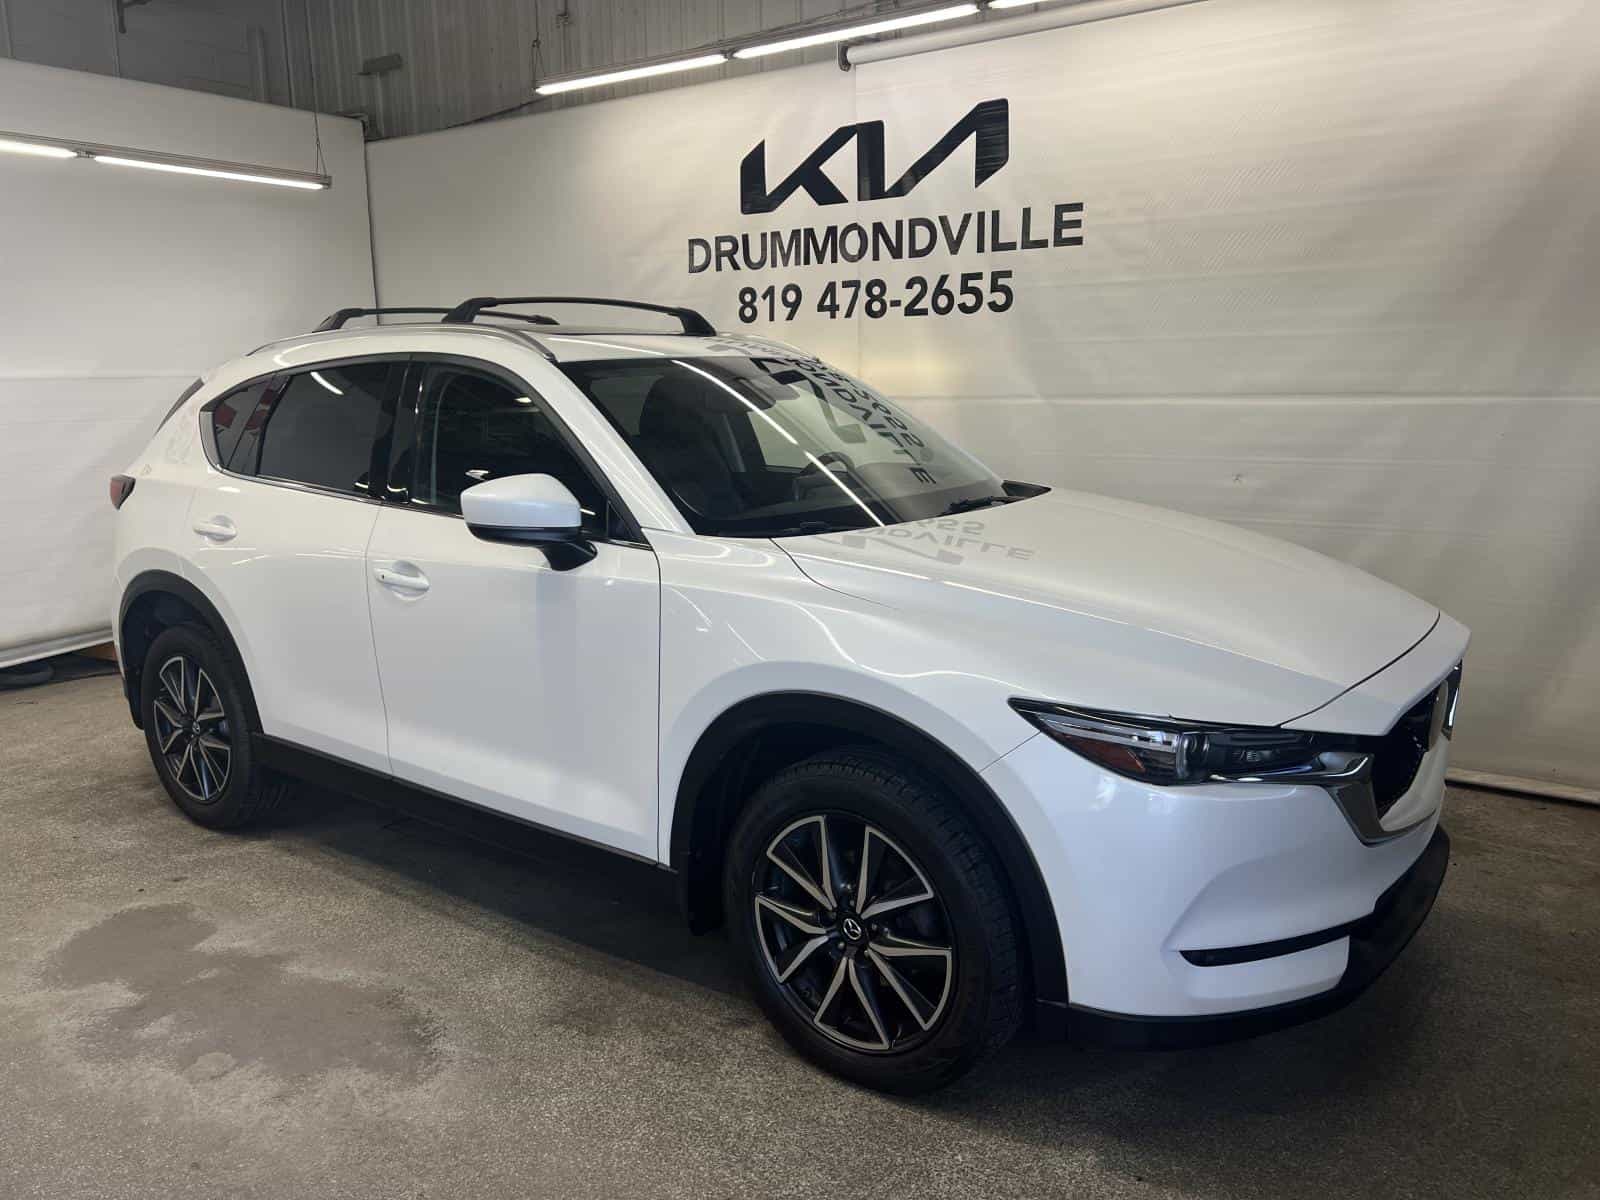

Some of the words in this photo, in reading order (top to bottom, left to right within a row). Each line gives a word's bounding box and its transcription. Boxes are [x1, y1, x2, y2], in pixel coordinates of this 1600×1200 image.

[740, 98, 1009, 214] KIA
[687, 202, 1084, 274] DRUMMONDVILLE
[738, 283, 803, 323] 819
[816, 270, 1014, 320] 478-2655
